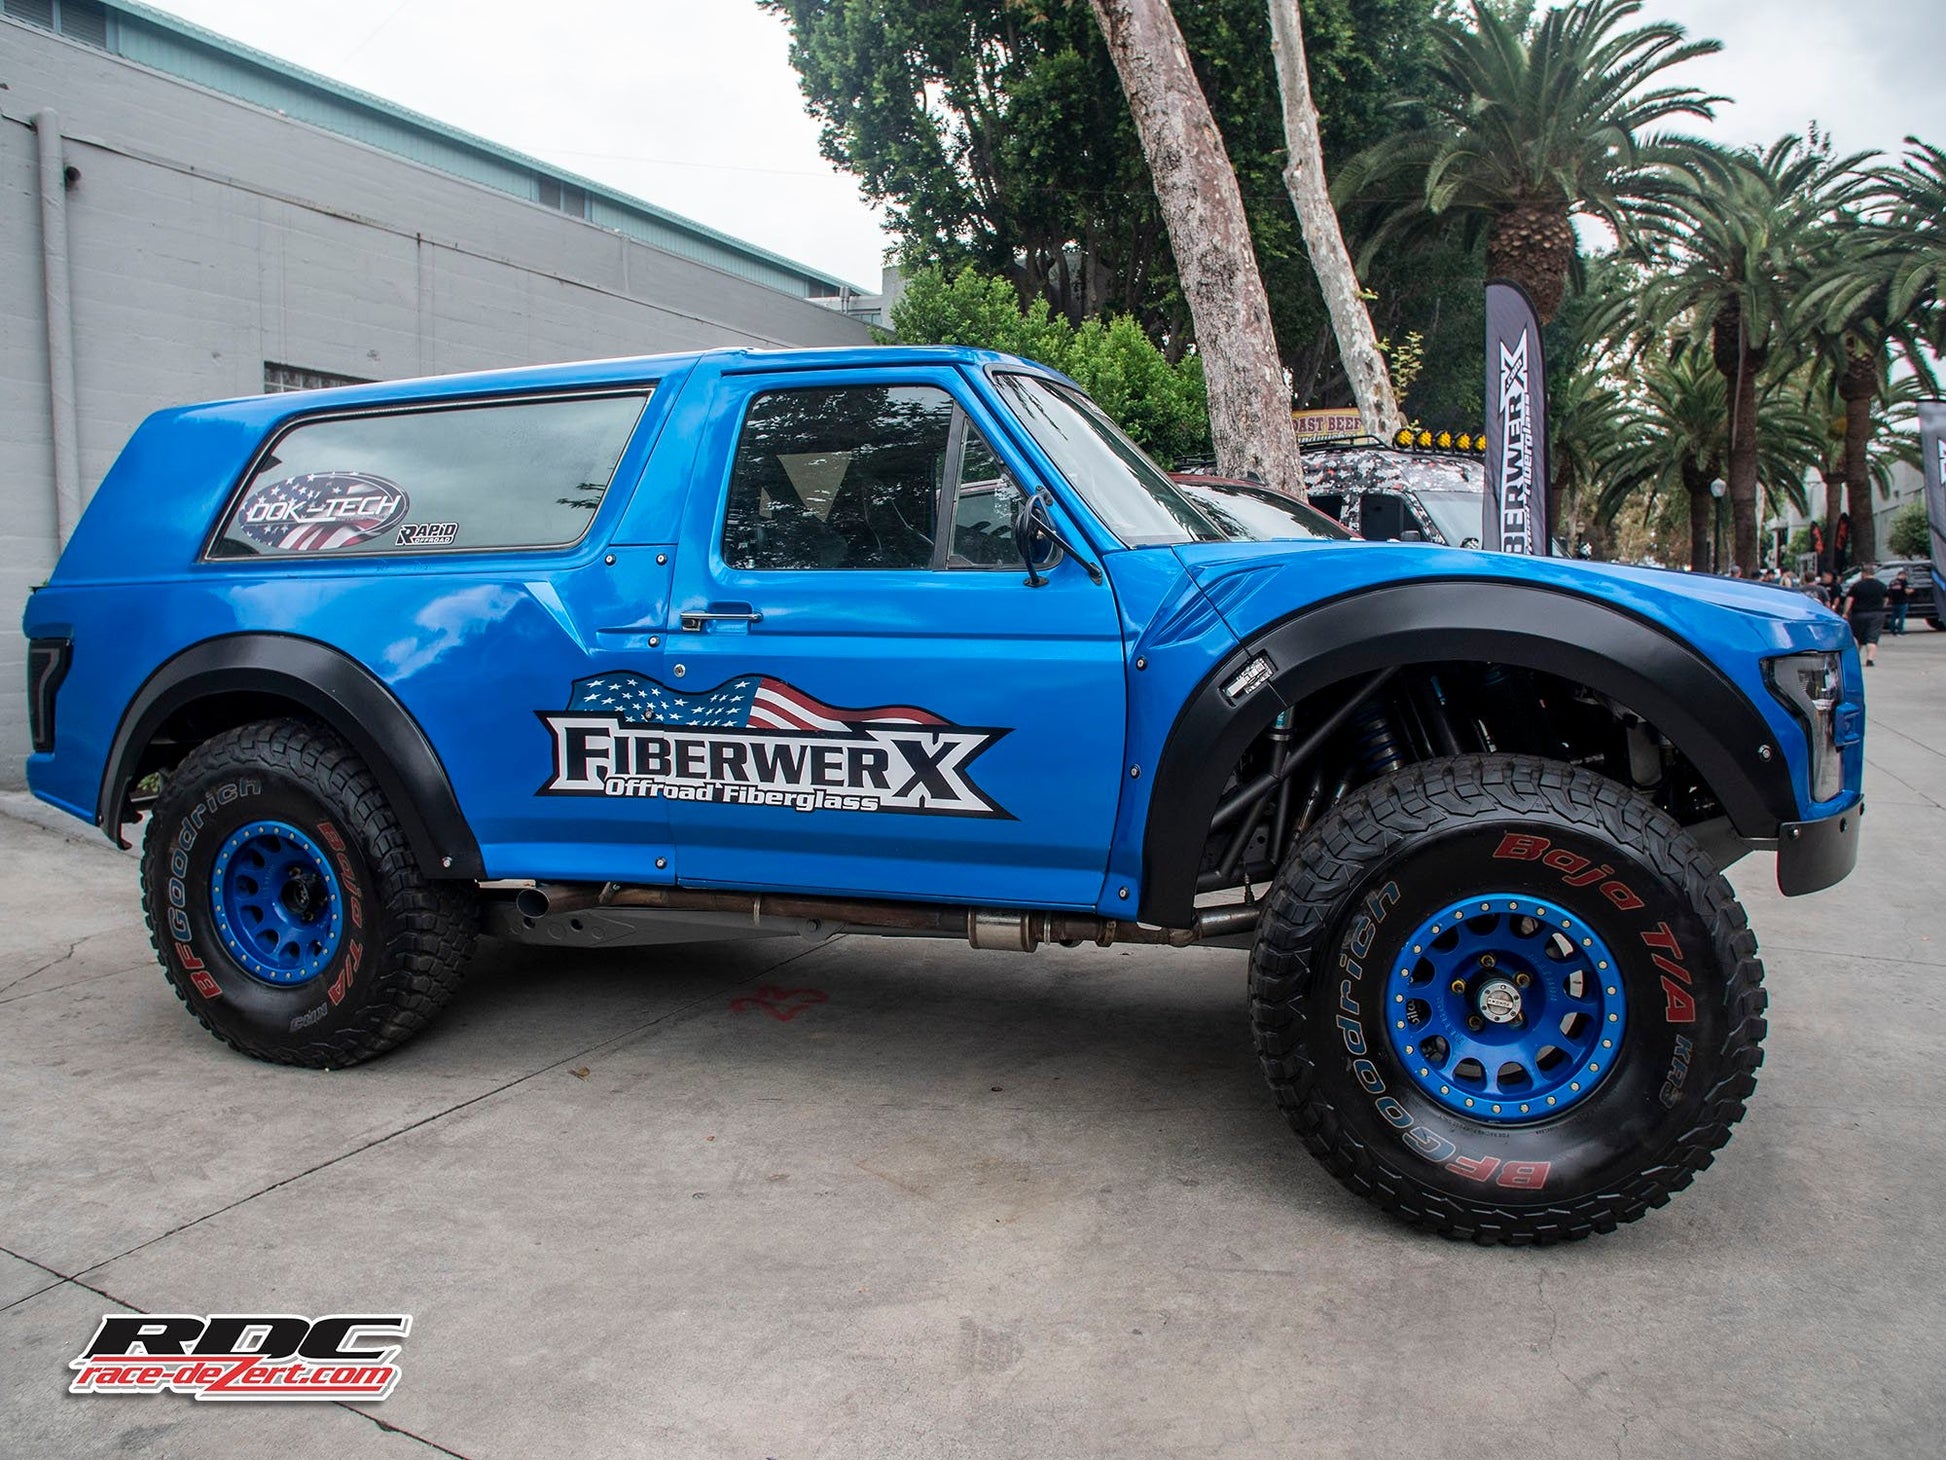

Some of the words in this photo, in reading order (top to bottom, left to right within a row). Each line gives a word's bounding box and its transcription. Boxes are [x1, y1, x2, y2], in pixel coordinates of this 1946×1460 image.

[1328, 416, 1361, 431] BEEF
[562, 724, 968, 802] FIBERWERX
[604, 777, 714, 801] Offroad
[724, 780, 879, 811] Fiberglass
[168, 777, 262, 999] BFGoodrich
[317, 822, 363, 929] Baja
[327, 939, 363, 1006] T/A
[1493, 833, 1648, 910] Baja
[1640, 922, 1695, 1023] T/A
[1335, 880, 1551, 1190] BFGoodrich
